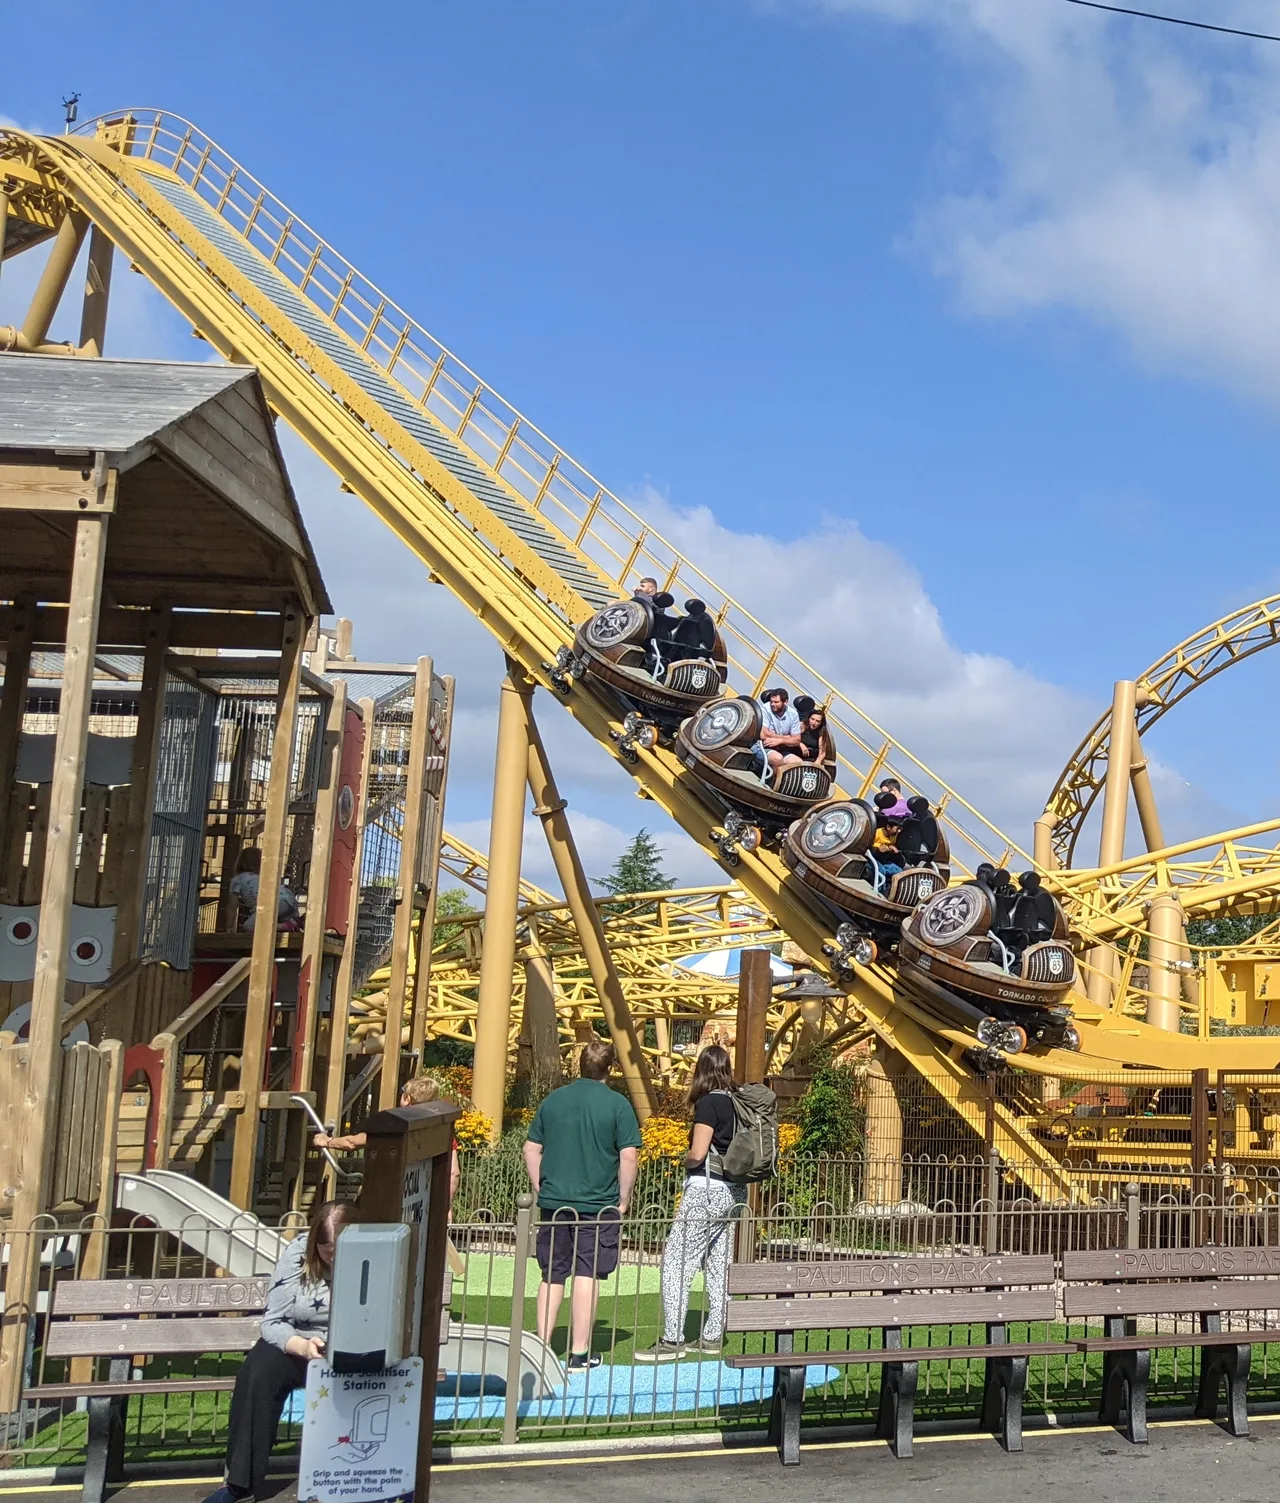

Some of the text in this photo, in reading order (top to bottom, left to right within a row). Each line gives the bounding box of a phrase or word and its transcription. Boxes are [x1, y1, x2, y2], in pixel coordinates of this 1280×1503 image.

[694, 676, 704, 686] 83
[641, 691, 676, 707] TORNADO
[804, 779, 814, 788] 83
[920, 886, 930, 896] 83
[1052, 960, 1061, 972] 83
[998, 988, 1036, 1001] TORNADO
[1123, 1251, 1235, 1274] PAULTONS
[795, 1261, 995, 1287] PAULTONS PARK
[136, 1282, 269, 1308] PAULTON
[343, 1380, 386, 1391] Station
[312, 1467, 403, 1478] Grip and squeeze the
[313, 1475, 401, 1486] button with the palm
[328, 1485, 385, 1495] of your hand.
